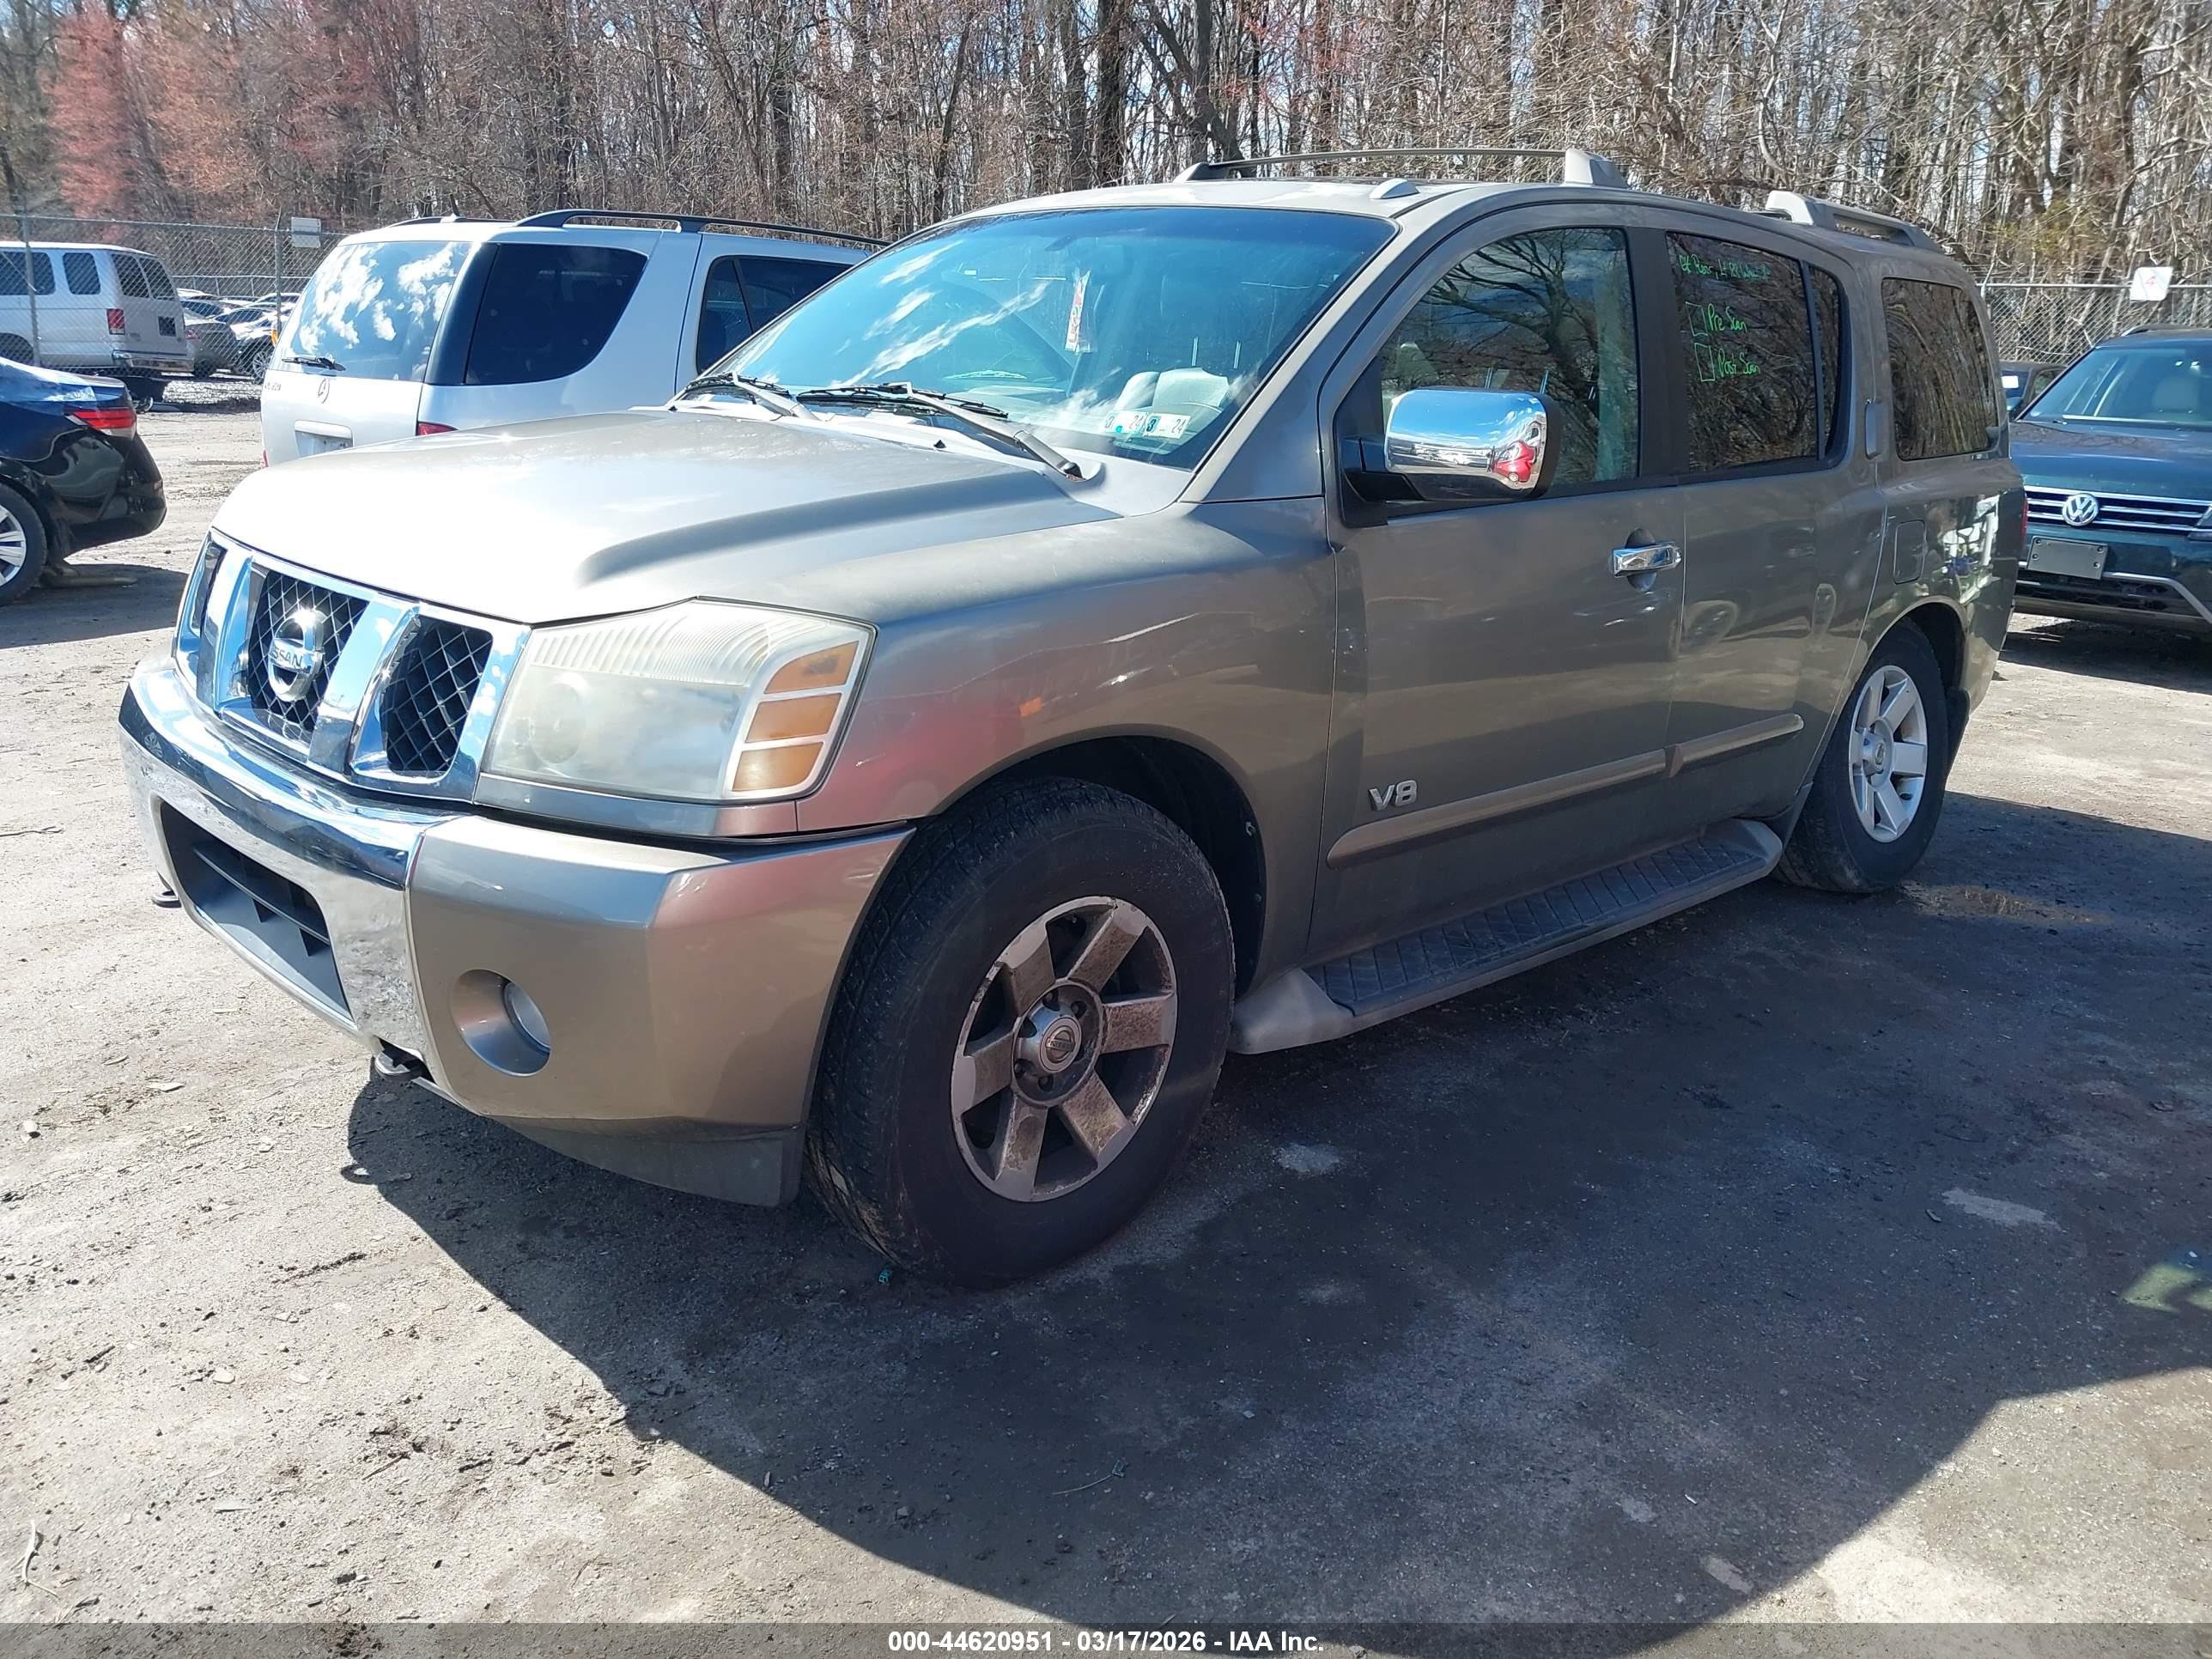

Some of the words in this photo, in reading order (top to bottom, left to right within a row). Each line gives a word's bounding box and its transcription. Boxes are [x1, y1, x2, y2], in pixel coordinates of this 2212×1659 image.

[1707, 303, 1725, 331] Pre
[1725, 306, 1747, 333] Scan
[1739, 351, 1761, 374] Scan
[1369, 780, 1418, 811] V8
